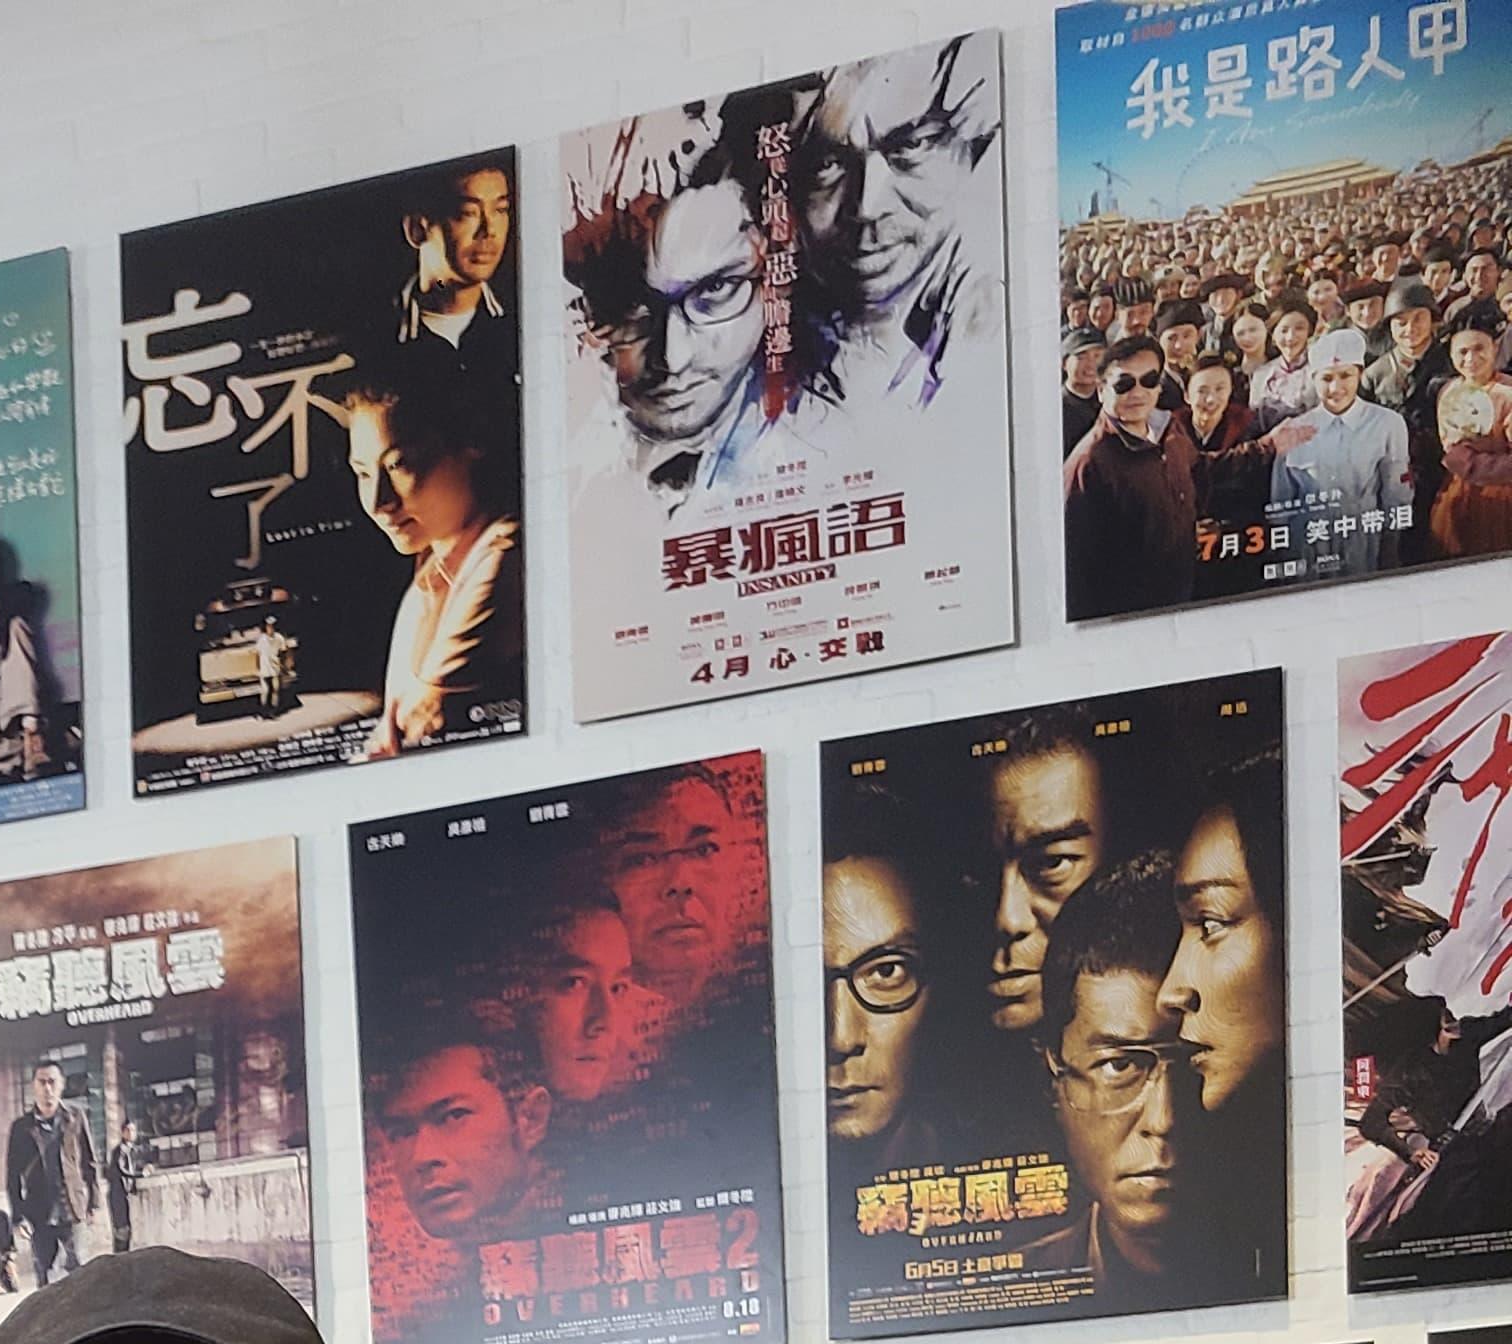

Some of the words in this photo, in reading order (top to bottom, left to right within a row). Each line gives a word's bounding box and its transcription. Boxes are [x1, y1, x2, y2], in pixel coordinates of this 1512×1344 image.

[1125, 0, 1469, 140] 我是路人甲
[121, 288, 356, 570] 忘不了
[660, 491, 906, 592] 暴瘋語
[1196, 526, 1290, 560] 7月3日
[1306, 504, 1414, 544] 笑中带泪
[739, 566, 835, 597] INSANITY
[691, 655, 750, 684] 4月
[65, 999, 155, 1027] OVERHEARD
[483, 1270, 760, 1326] OVERHEARD
